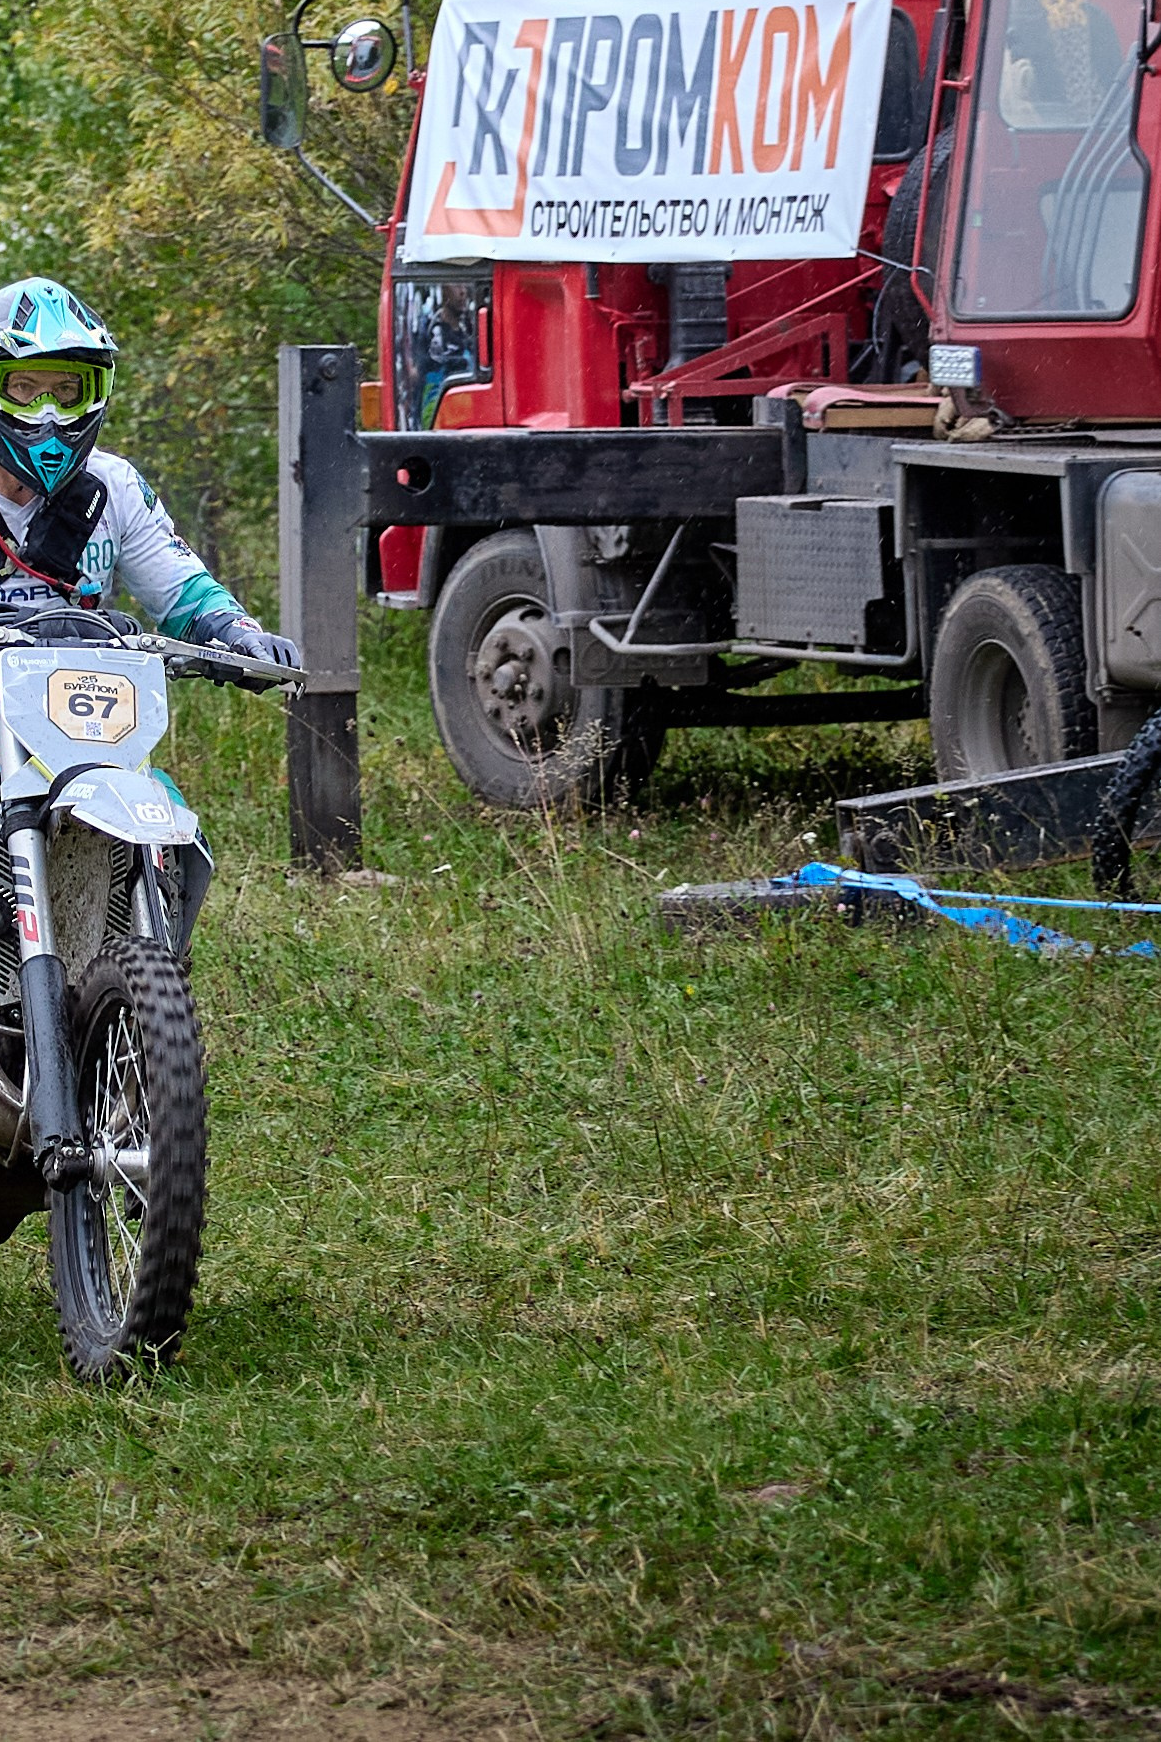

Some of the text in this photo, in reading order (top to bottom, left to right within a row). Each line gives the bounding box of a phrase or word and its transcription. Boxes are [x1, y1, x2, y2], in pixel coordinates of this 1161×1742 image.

[532, 2, 857, 177] ПРОМКОМ
[531, 193, 831, 239] СТРОИТЕЛЬСТВО И МОНТАЖ
[68, 693, 119, 719] 67
